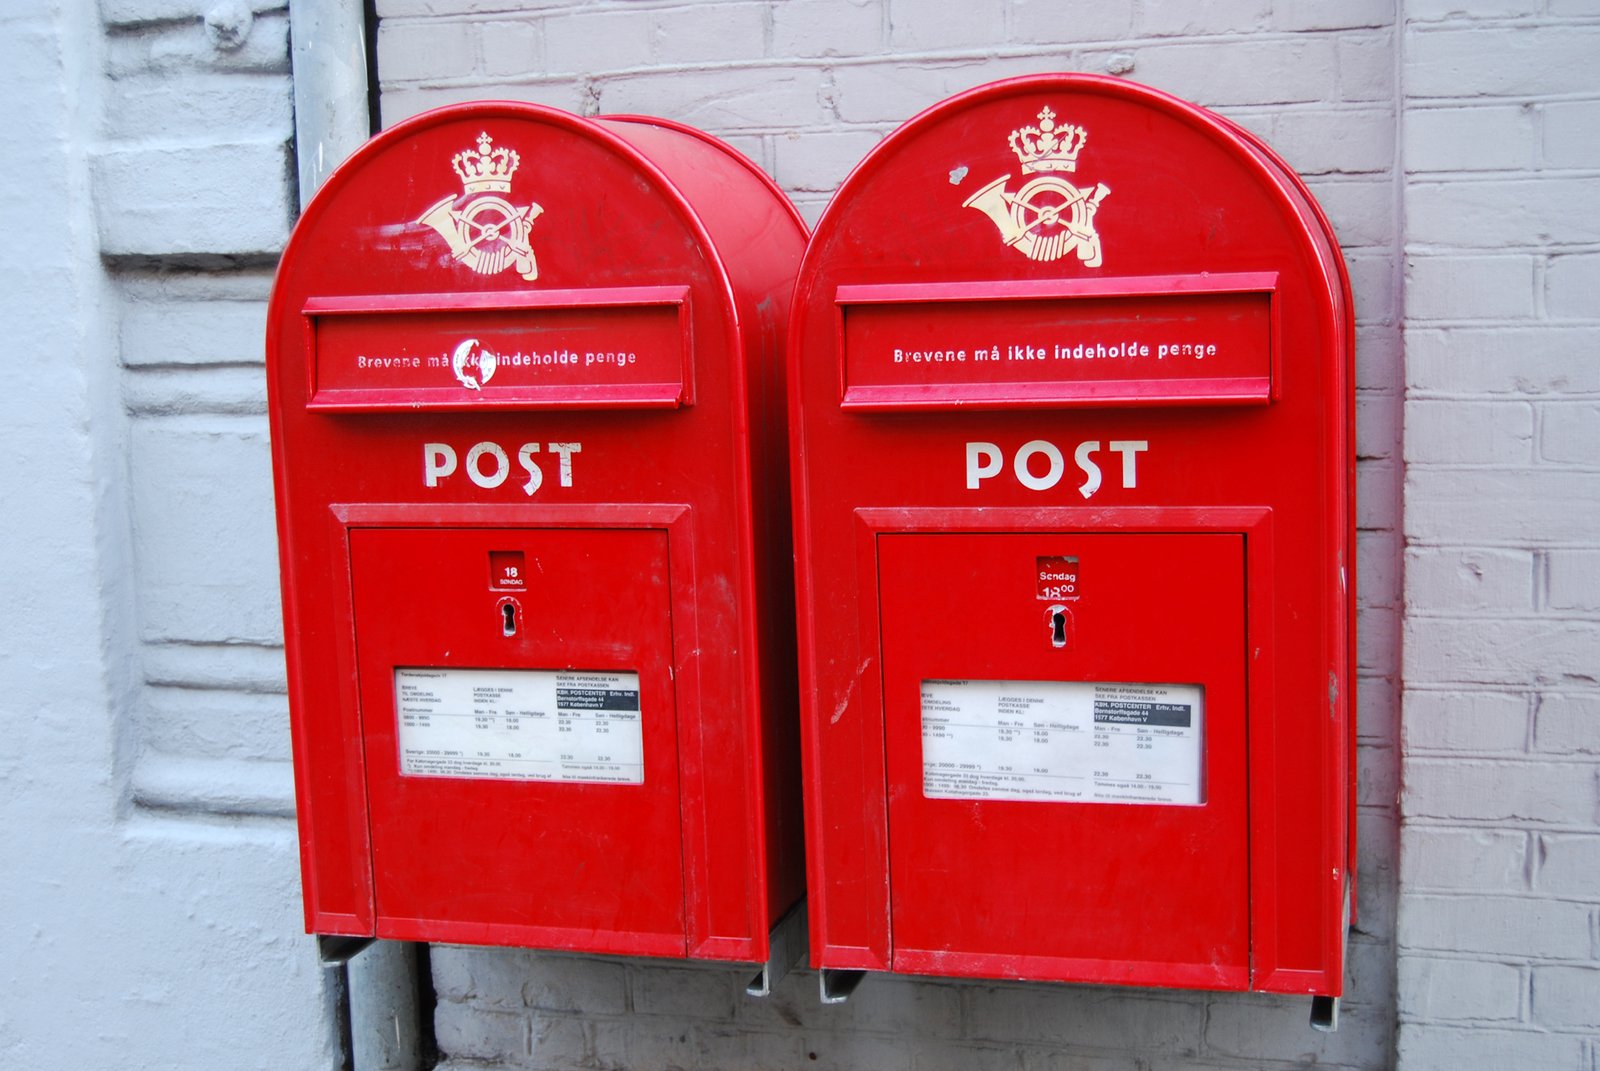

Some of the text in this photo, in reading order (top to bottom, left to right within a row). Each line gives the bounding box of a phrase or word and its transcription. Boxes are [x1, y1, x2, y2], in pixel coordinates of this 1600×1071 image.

[428, 354, 448, 367] må
[497, 350, 578, 366] indeholde
[586, 352, 636, 366] penge
[894, 342, 1216, 362] Brevene må ikke indeholde penge
[424, 441, 582, 496] POST
[966, 440, 1148, 499] POST
[505, 567, 518, 578] 18
